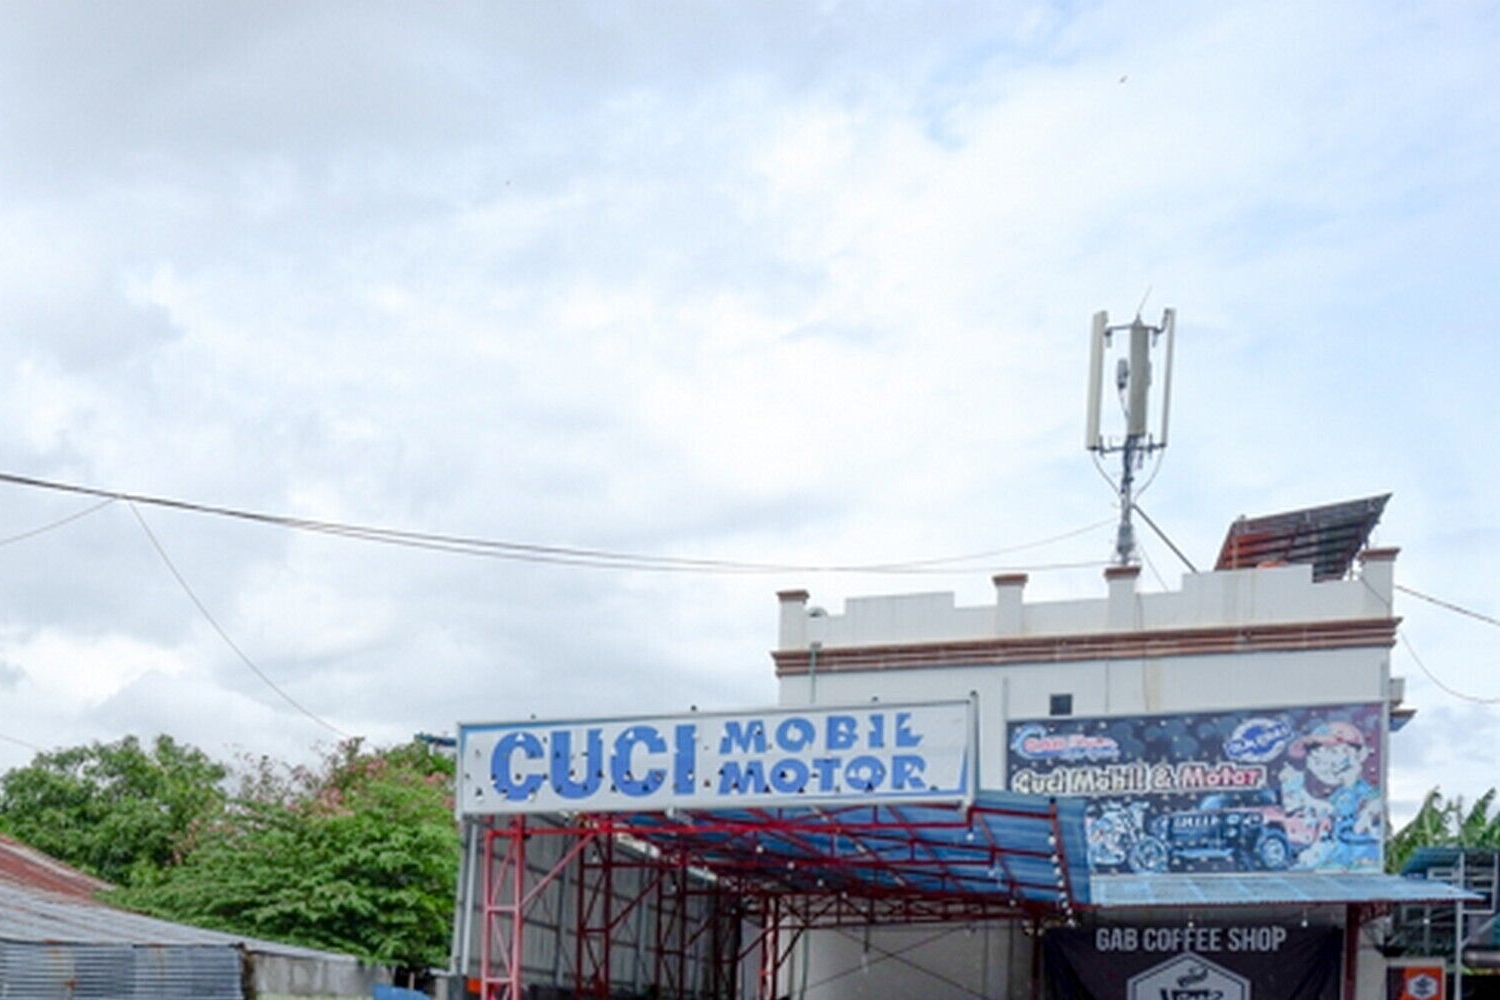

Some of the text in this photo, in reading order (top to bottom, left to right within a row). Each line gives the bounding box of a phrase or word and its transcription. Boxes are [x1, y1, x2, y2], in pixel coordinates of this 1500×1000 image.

[490, 712, 924, 801] CUCI MOBIL
[718, 755, 927, 797] MOTOR
[1071, 765, 1146, 792] Mobil
[1152, 766, 1174, 789] &
[1180, 765, 1264, 788] Motor
[1096, 925, 1287, 952] GAB COFFEE SHOP
